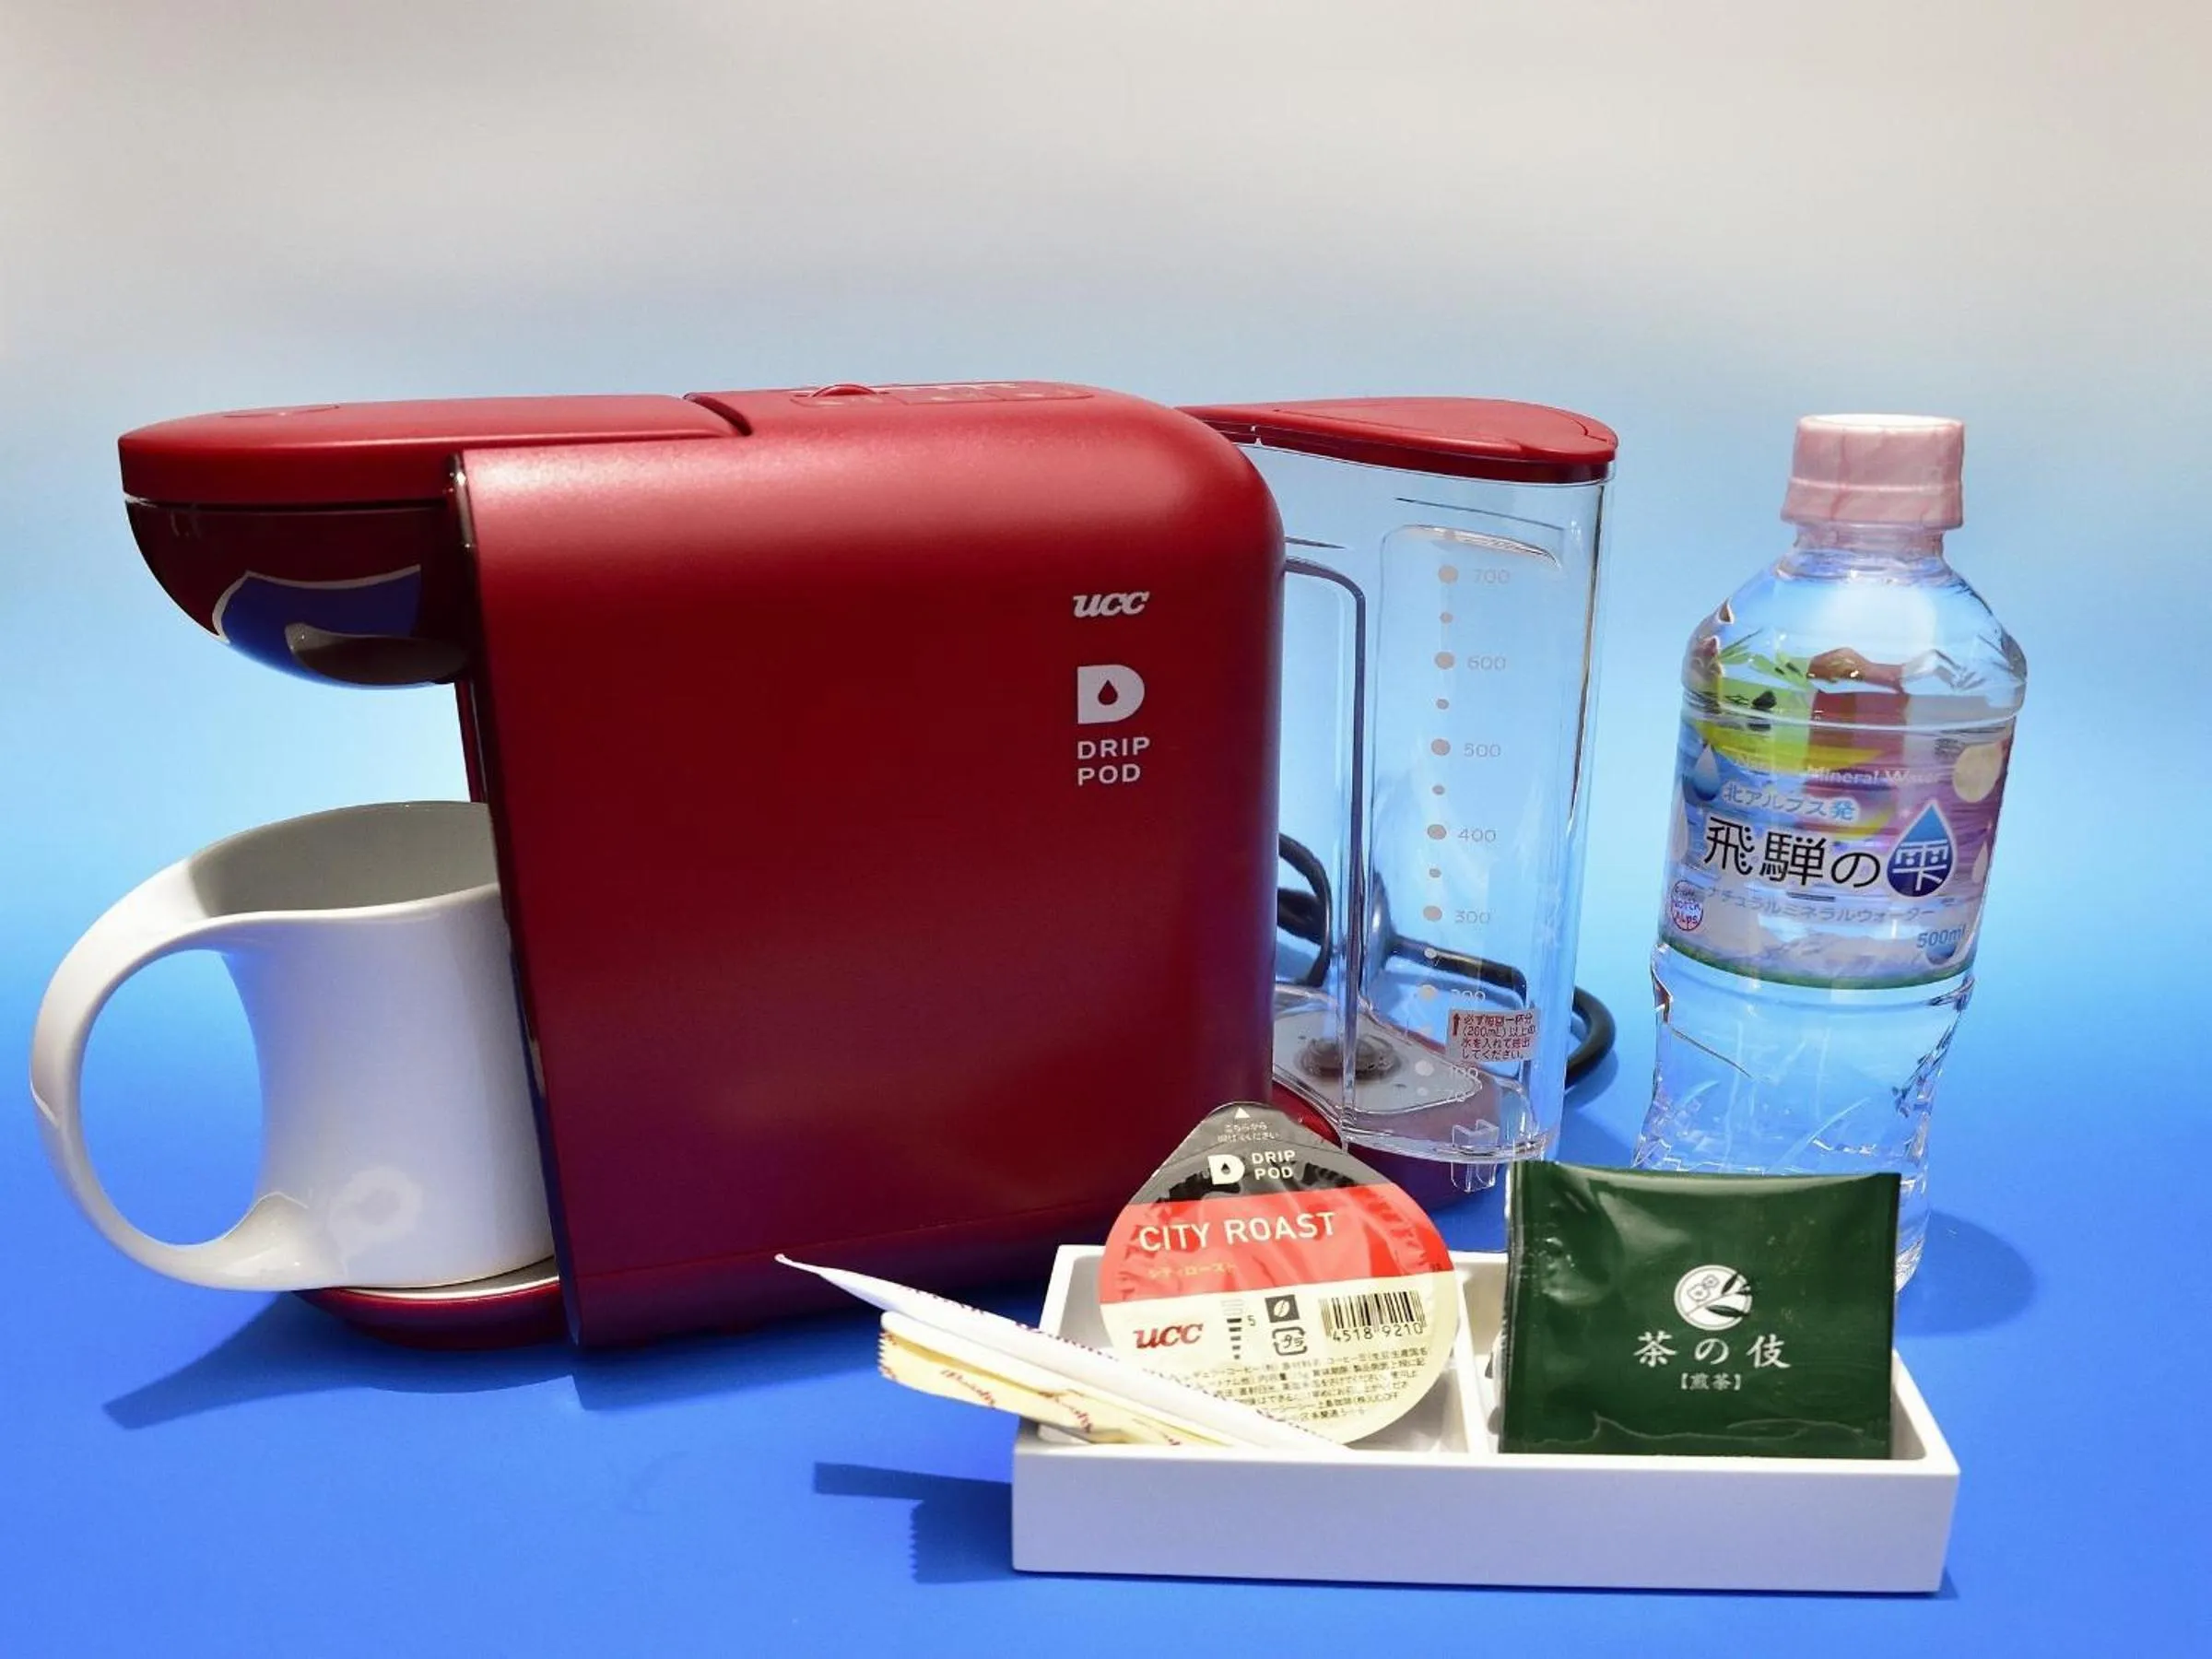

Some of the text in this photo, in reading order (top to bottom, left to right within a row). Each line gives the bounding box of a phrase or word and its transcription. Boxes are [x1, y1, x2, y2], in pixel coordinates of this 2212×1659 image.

[1474, 569, 1510, 584] 700
[1467, 655, 1506, 670] 600
[1077, 737, 1150, 759] DRIP
[1463, 743, 1501, 757] 500
[1077, 764, 1141, 785] POD
[1806, 765, 1879, 784] Mineral
[1723, 782, 1855, 822] 北アルプス発
[1458, 829, 1497, 842] 400
[1455, 910, 1490, 924] 300
[1252, 1150, 1296, 1164] DRIP
[1254, 1166, 1293, 1180] POD
[1139, 1212, 1335, 1252] CITY ROAST
[1247, 1314, 1256, 1327] 5
[1333, 1322, 1424, 1343] 4518 9210
